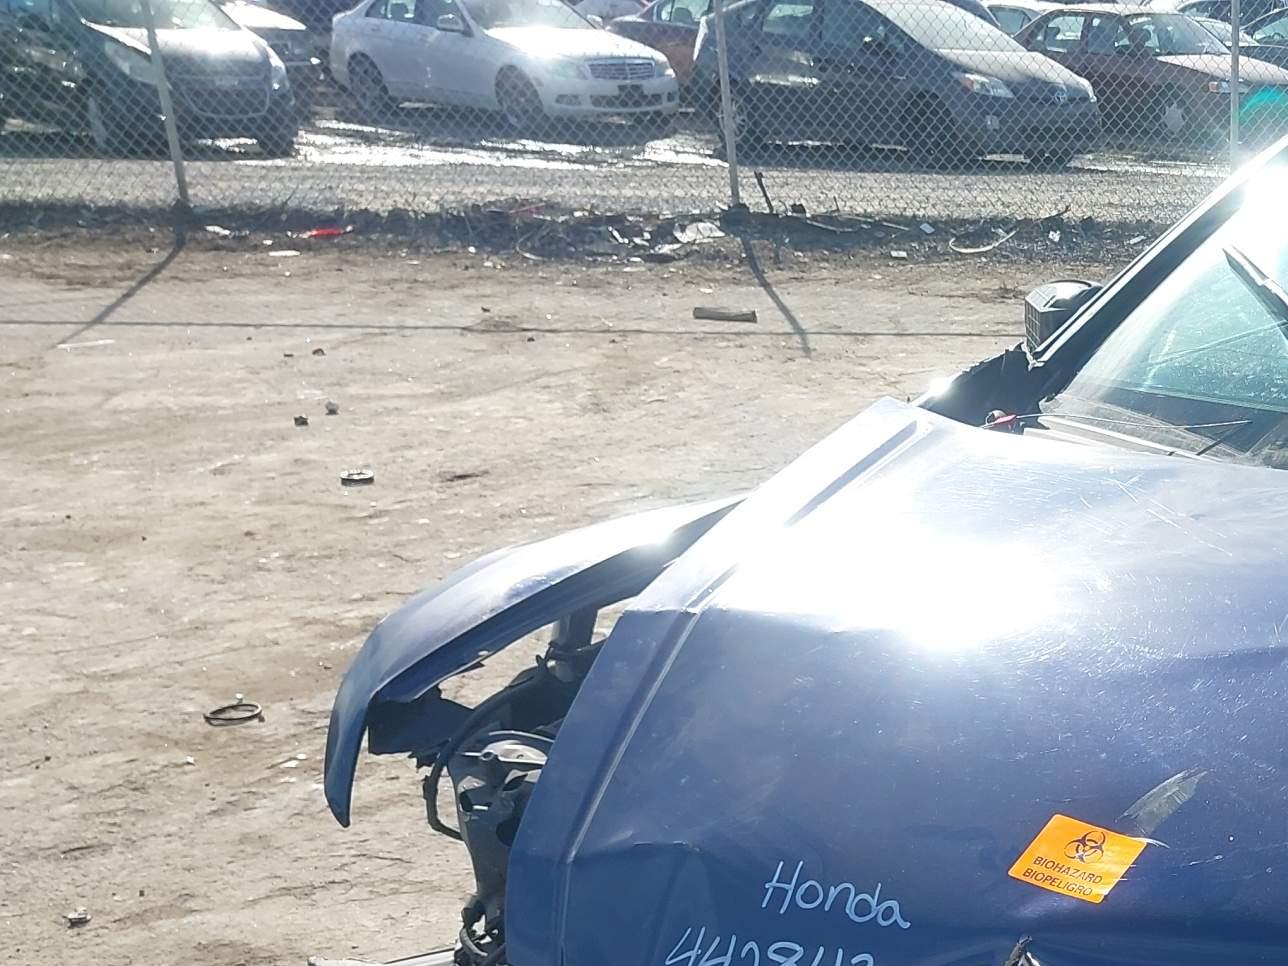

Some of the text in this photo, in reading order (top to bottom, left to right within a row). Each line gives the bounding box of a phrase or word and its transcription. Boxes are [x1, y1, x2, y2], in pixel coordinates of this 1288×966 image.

[1022, 867, 1093, 896] BIOPELIGRO
[1033, 855, 1102, 885] BIOHAZARD
[761, 860, 911, 929] Honda
